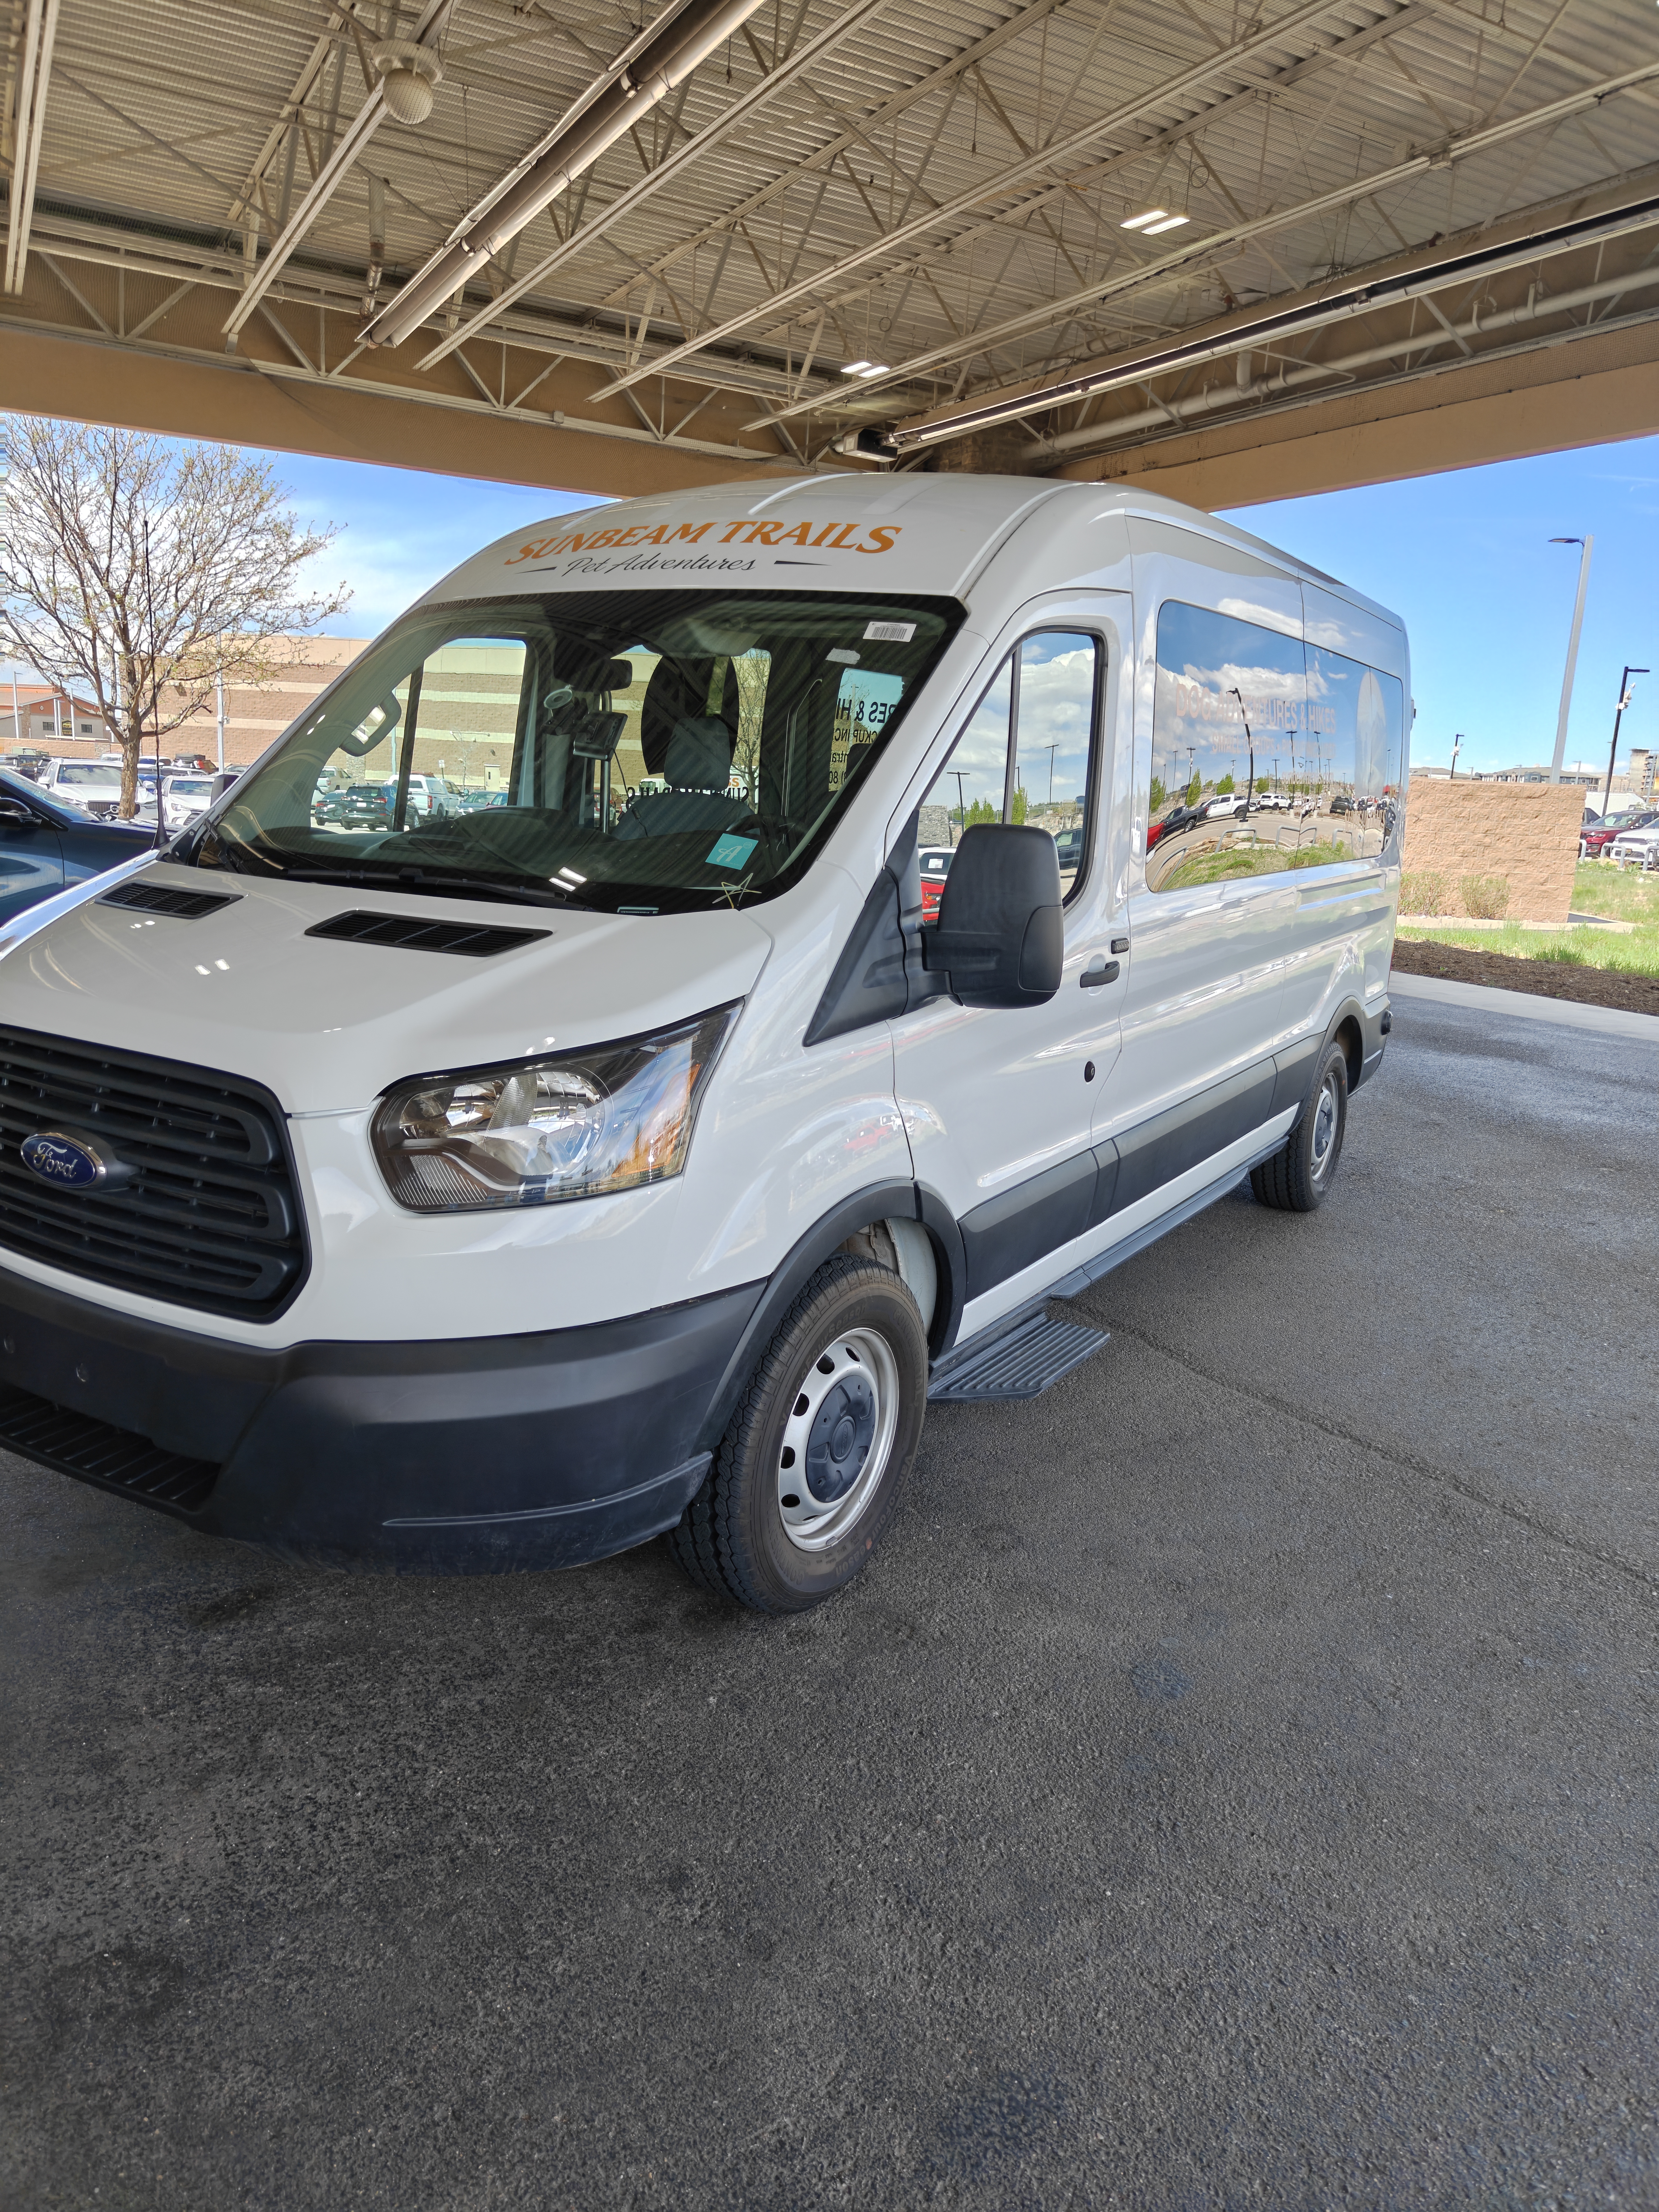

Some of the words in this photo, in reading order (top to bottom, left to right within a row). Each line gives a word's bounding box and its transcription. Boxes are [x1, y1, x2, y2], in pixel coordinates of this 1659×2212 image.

[504, 521, 718, 565] SUNBEAM
[719, 520, 903, 554] TRAILS
[562, 557, 610, 577] Pet
[604, 553, 757, 571] Adventures
[1176, 683, 1211, 721] DOG
[1215, 690, 1297, 730] ADVENTURES
[1299, 704, 1307, 730] &
[1308, 705, 1336, 734] HIKES
[1212, 733, 1241, 754] SMALL
[1243, 735, 1275, 756] GROUPS
[33, 1142, 78, 1179] Ford
